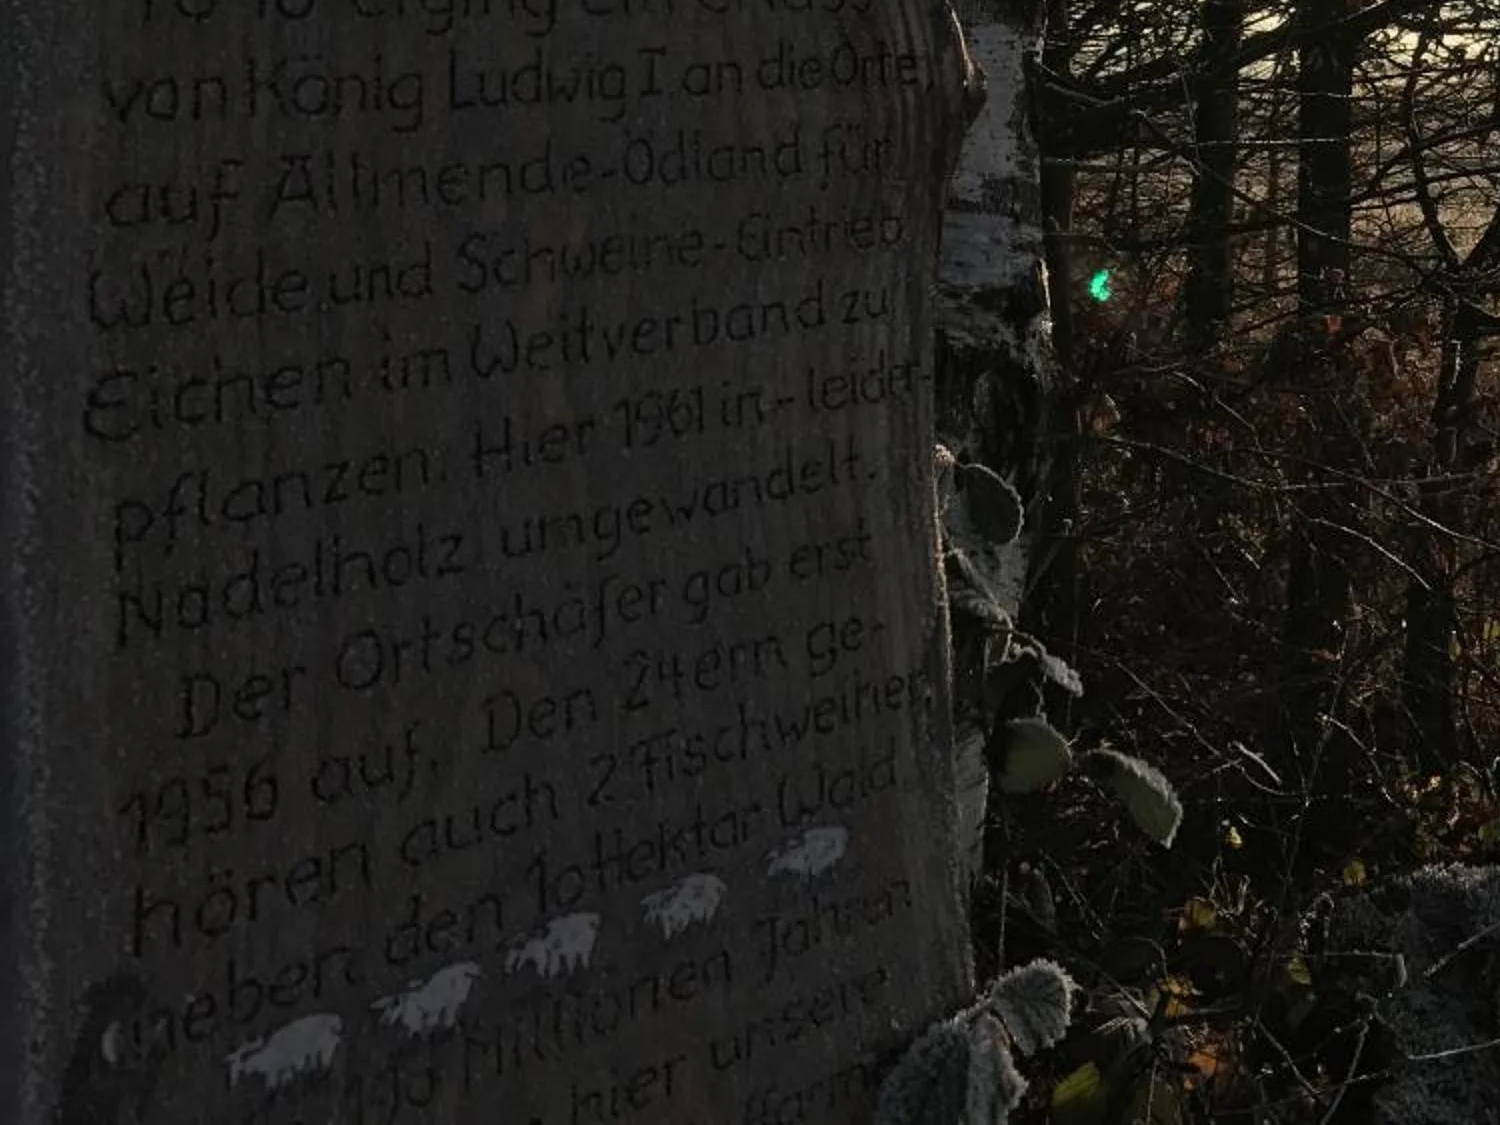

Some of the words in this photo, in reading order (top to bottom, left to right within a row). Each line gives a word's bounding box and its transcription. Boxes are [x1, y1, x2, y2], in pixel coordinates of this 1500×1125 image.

[246, 53, 424, 134] König
[448, 46, 627, 122] Ludwig
[680, 60, 744, 97] an
[755, 39, 823, 90] die
[105, 157, 245, 243] auf
[815, 122, 894, 192] für
[87, 245, 309, 331] Weide
[328, 240, 434, 306] und
[82, 354, 352, 442] Eichen
[381, 329, 452, 393] im
[471, 278, 826, 379] Weitverband
[839, 286, 890, 325] zu
[471, 413, 596, 477] Hier
[611, 385, 705, 450] 1961
[116, 522, 465, 648] Nadelholz
[176, 666, 306, 740] Der
[682, 545, 772, 624] gab
[789, 517, 873, 581] erst
[116, 761, 279, 856] 1956
[480, 687, 597, 755] Den
[131, 841, 375, 958] hören
[399, 773, 559, 868] auch
[384, 893, 503, 966] den
